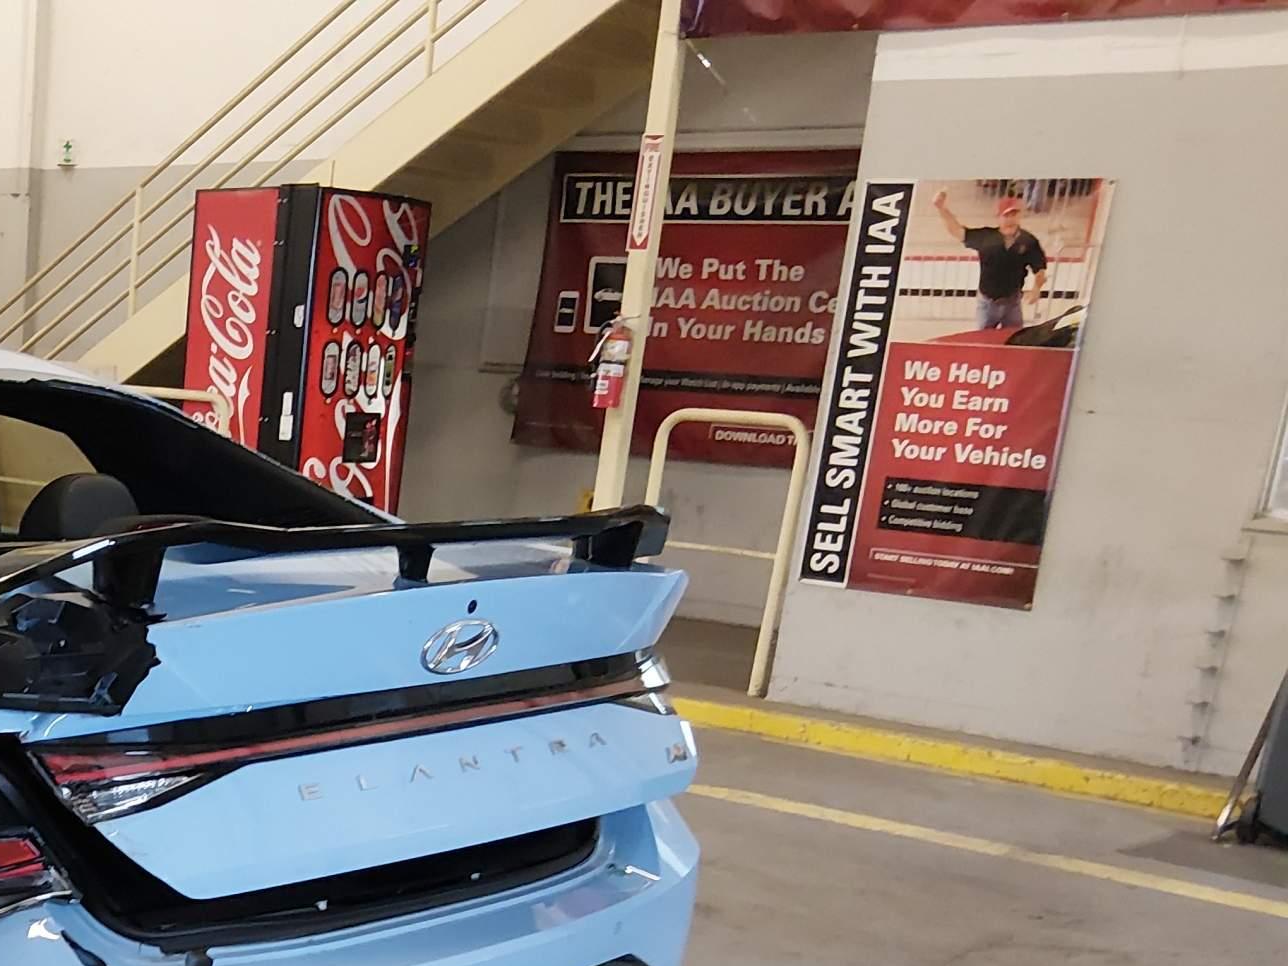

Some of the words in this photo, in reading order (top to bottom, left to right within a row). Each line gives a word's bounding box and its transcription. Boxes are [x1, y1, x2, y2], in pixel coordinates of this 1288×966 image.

[575, 181, 632, 216] THE
[708, 180, 829, 216] BUYER
[865, 191, 905, 254] IAA
[656, 257, 693, 280] We
[701, 258, 746, 281] Put
[755, 258, 805, 282] The
[651, 287, 697, 310] IAA
[701, 288, 801, 313] Auction
[846, 265, 892, 358] WITH
[647, 316, 669, 339] In
[677, 317, 735, 340] Your
[743, 319, 825, 344] Hands
[904, 360, 941, 382] We
[948, 363, 1006, 389] Help
[901, 386, 944, 409] You
[952, 390, 1009, 413] Earn
[715, 430, 785, 445] DOWNLOAD
[825, 365, 874, 489] SMART
[894, 412, 958, 436] More
[965, 417, 1008, 439] For
[892, 438, 947, 461] Your
[954, 443, 1047, 470] Vehicle
[810, 499, 851, 574] SELL
[298, 731, 608, 801] ELANTRA
[665, 743, 689, 764] N
